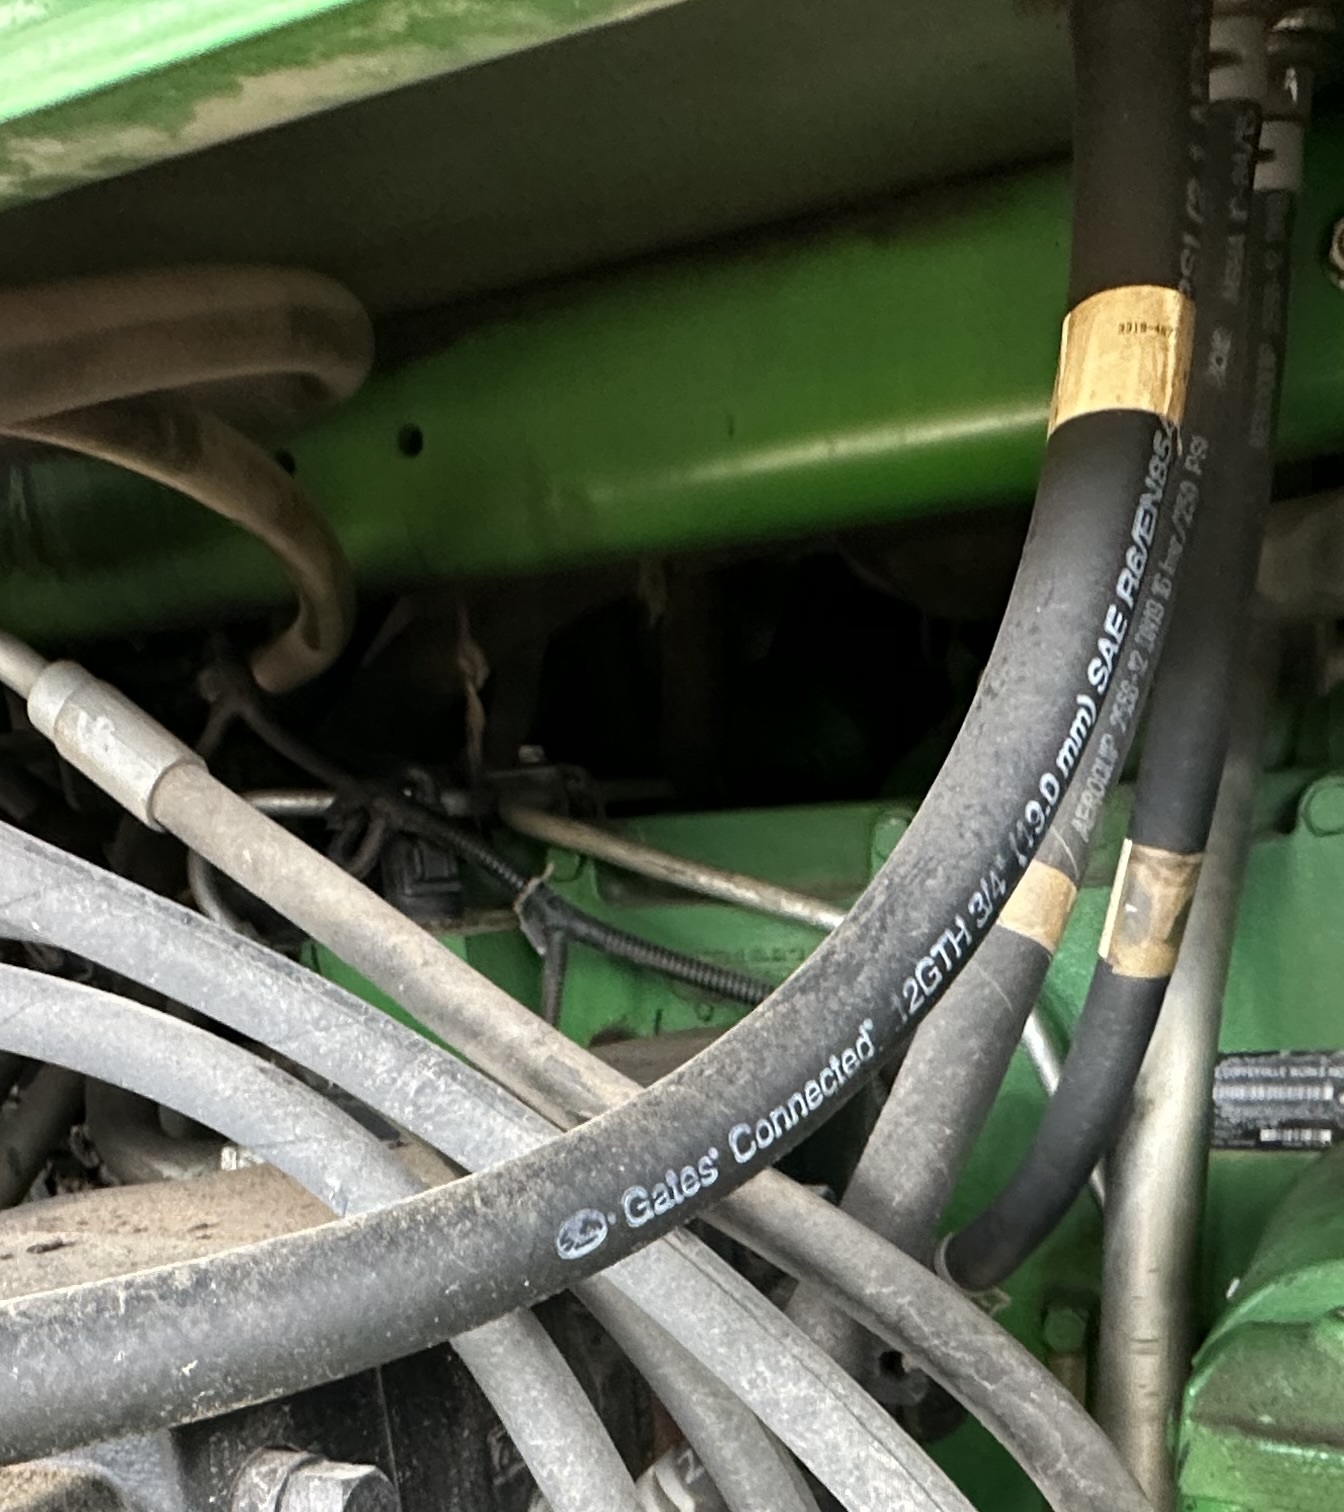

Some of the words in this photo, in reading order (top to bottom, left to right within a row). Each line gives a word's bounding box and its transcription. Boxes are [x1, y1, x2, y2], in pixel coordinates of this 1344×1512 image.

[621, 1153, 719, 1228] Gates
[728, 1021, 875, 1163] Connected
[1008, 772, 1060, 867] (19.0
[1056, 694, 1097, 778] mm)
[1087, 604, 1128, 694] SAE
